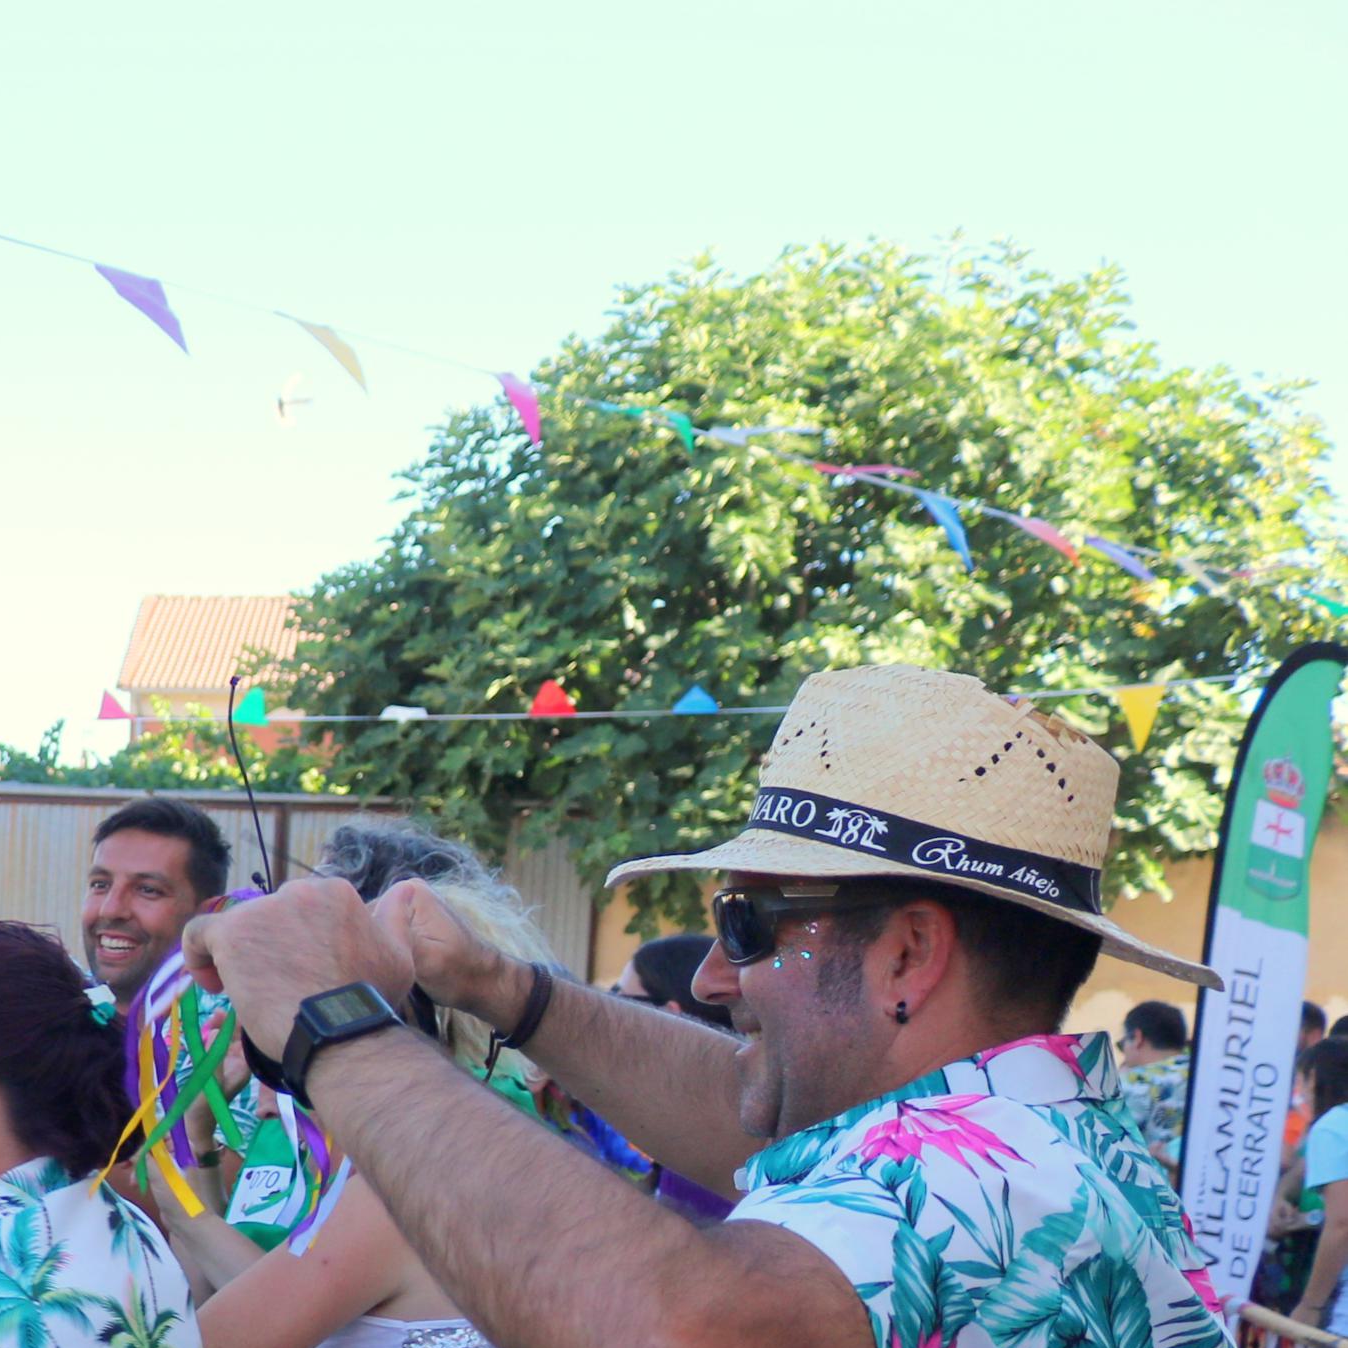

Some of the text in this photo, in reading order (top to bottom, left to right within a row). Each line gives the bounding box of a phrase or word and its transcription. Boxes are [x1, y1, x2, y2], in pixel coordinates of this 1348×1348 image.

[911, 836, 1004, 876] Rhum
[1008, 866, 1060, 898] Añejo
[1198, 957, 1263, 1267] VILLAMURIEL
[1229, 1063, 1279, 1279] DE CERRATO
